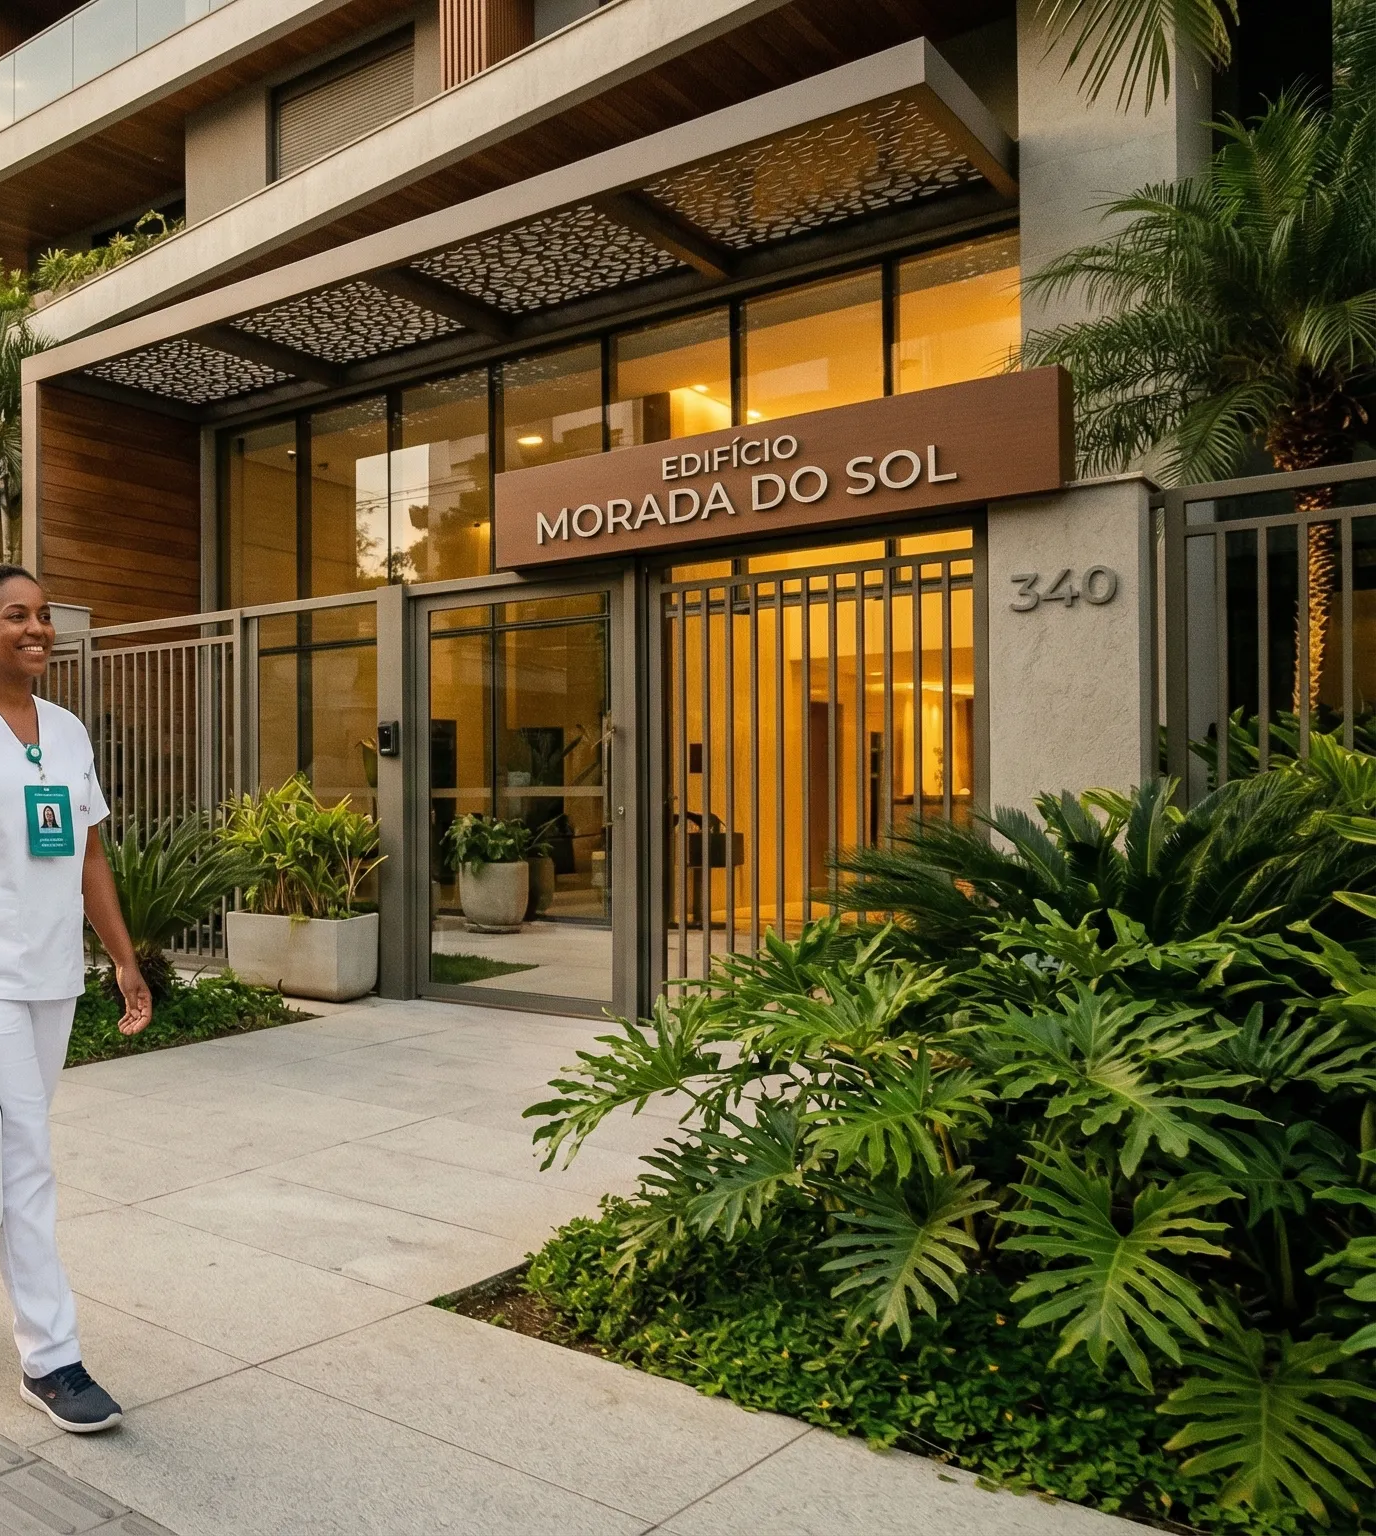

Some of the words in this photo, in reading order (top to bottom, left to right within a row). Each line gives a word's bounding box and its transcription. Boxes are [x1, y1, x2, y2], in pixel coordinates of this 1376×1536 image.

[661, 435, 798, 481] EDIFÍCIO
[536, 481, 736, 545] MORADA
[751, 465, 828, 511] DO
[845, 444, 958, 496] SOL
[1009, 564, 1118, 613] 340
